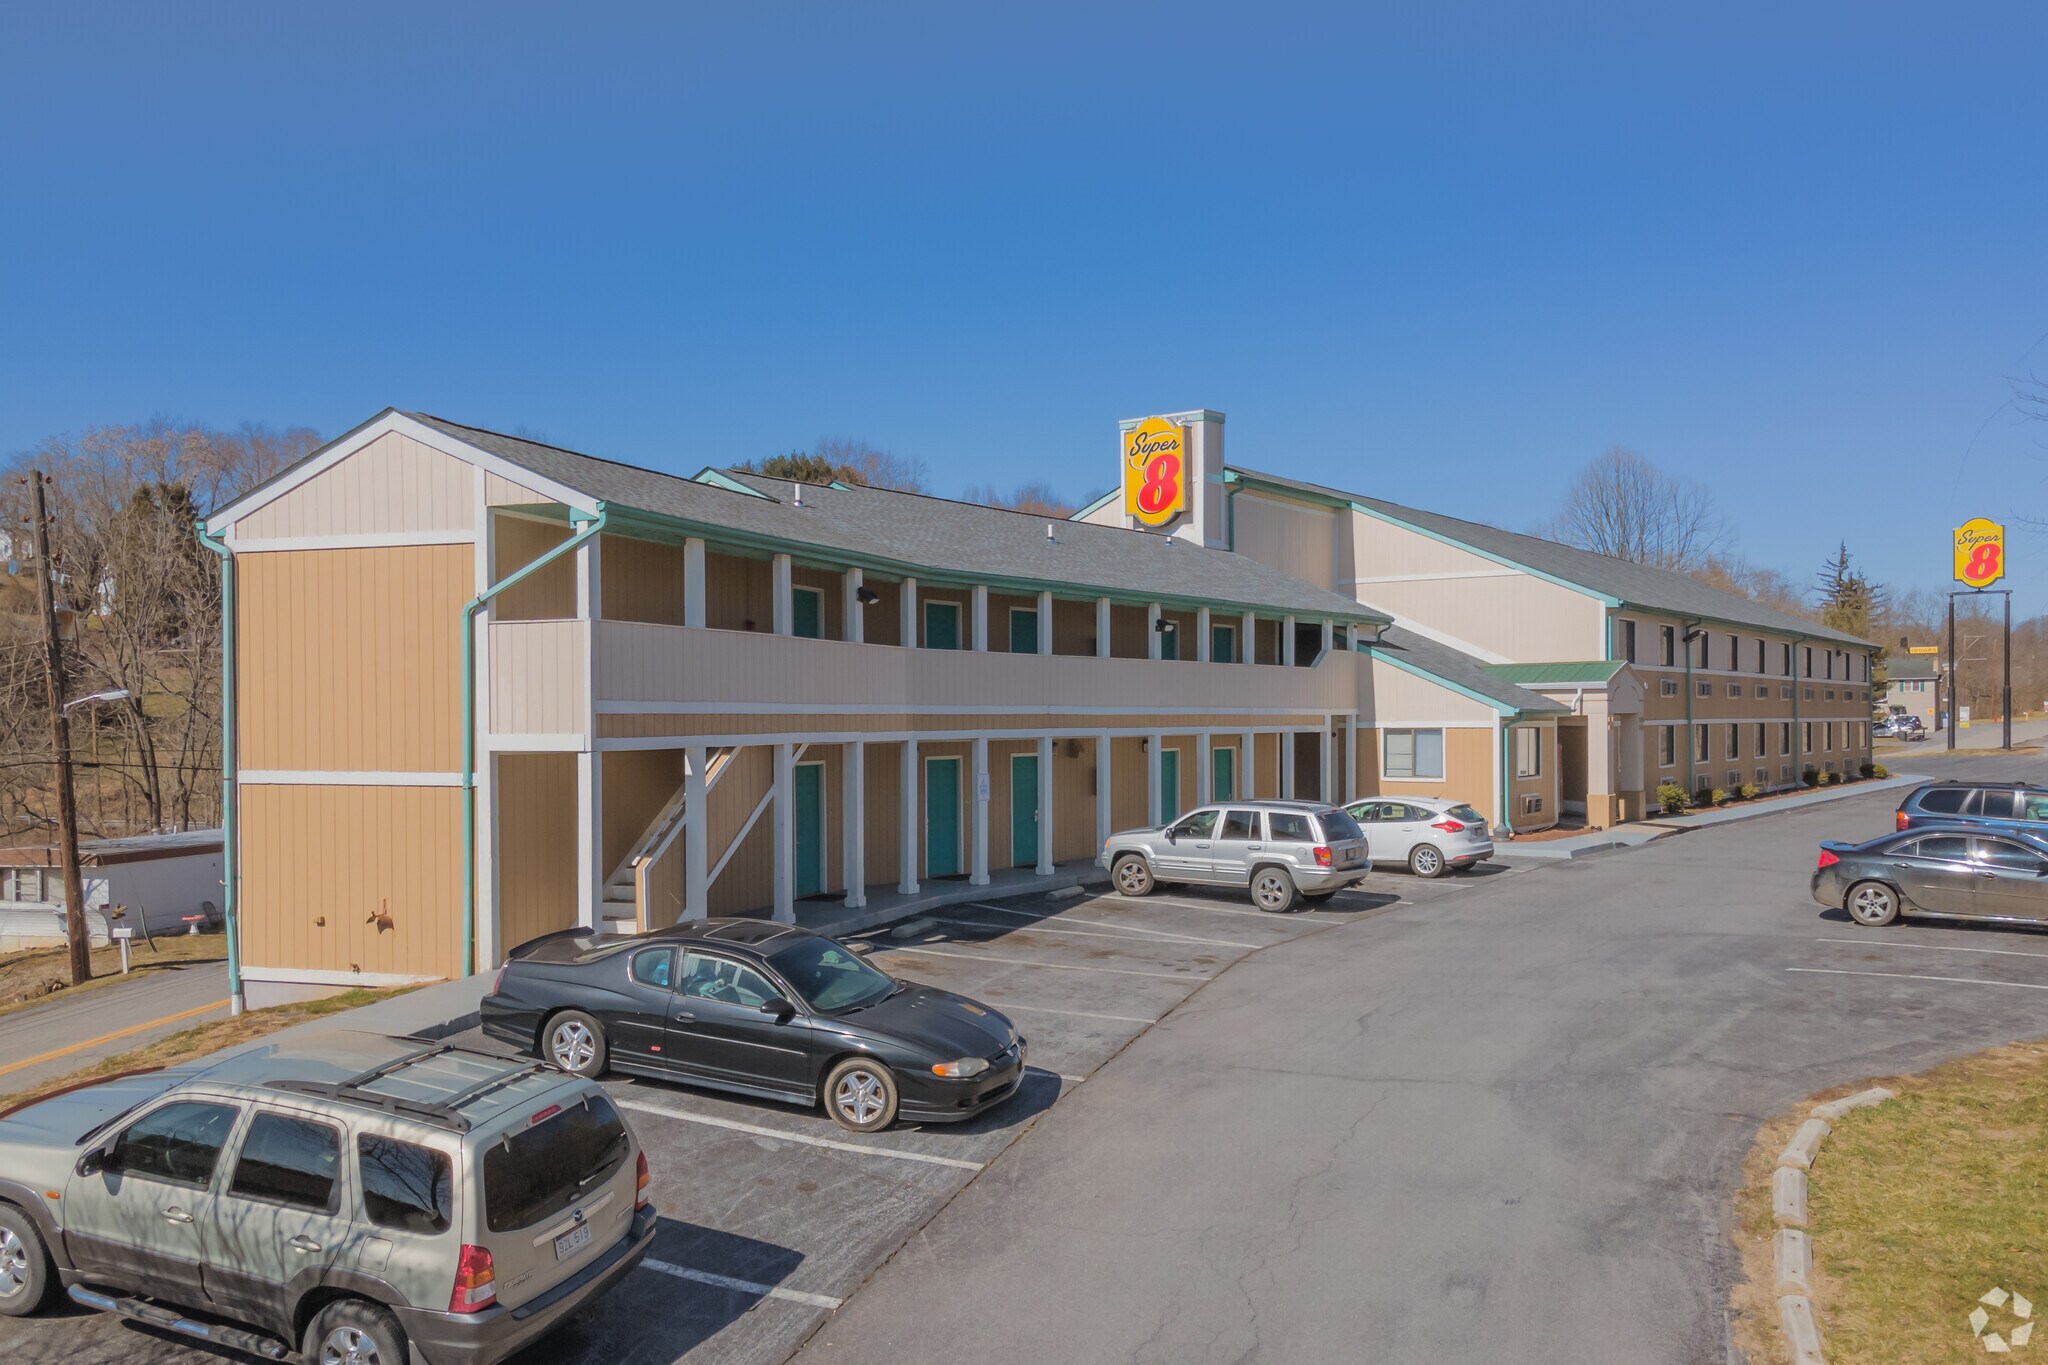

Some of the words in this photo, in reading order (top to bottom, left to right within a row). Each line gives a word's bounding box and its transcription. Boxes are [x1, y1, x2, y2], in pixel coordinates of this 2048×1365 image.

[1129, 431, 1180, 467] Super
[1136, 453, 1181, 515] 8
[1957, 529, 2001, 551] Super
[1963, 543, 2002, 581] 8
